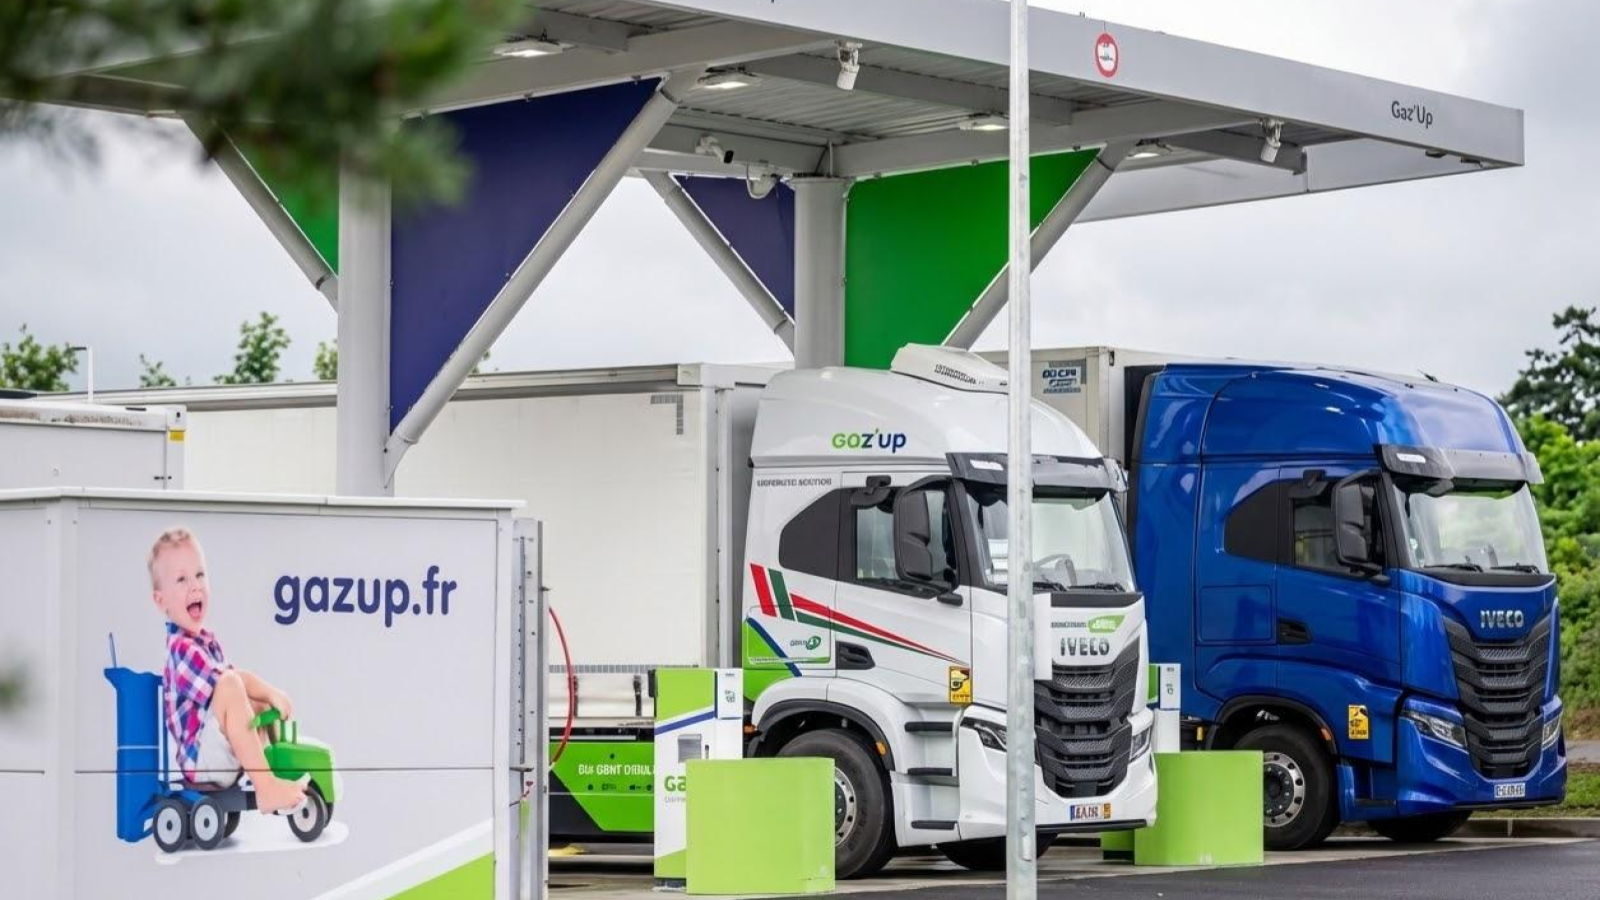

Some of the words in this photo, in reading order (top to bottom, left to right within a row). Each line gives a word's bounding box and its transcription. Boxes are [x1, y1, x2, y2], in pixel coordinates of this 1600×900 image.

[1391, 100, 1433, 129] Gaz'Up
[273, 565, 457, 628] gazup.fr
[1480, 609, 1524, 629] IVECO
